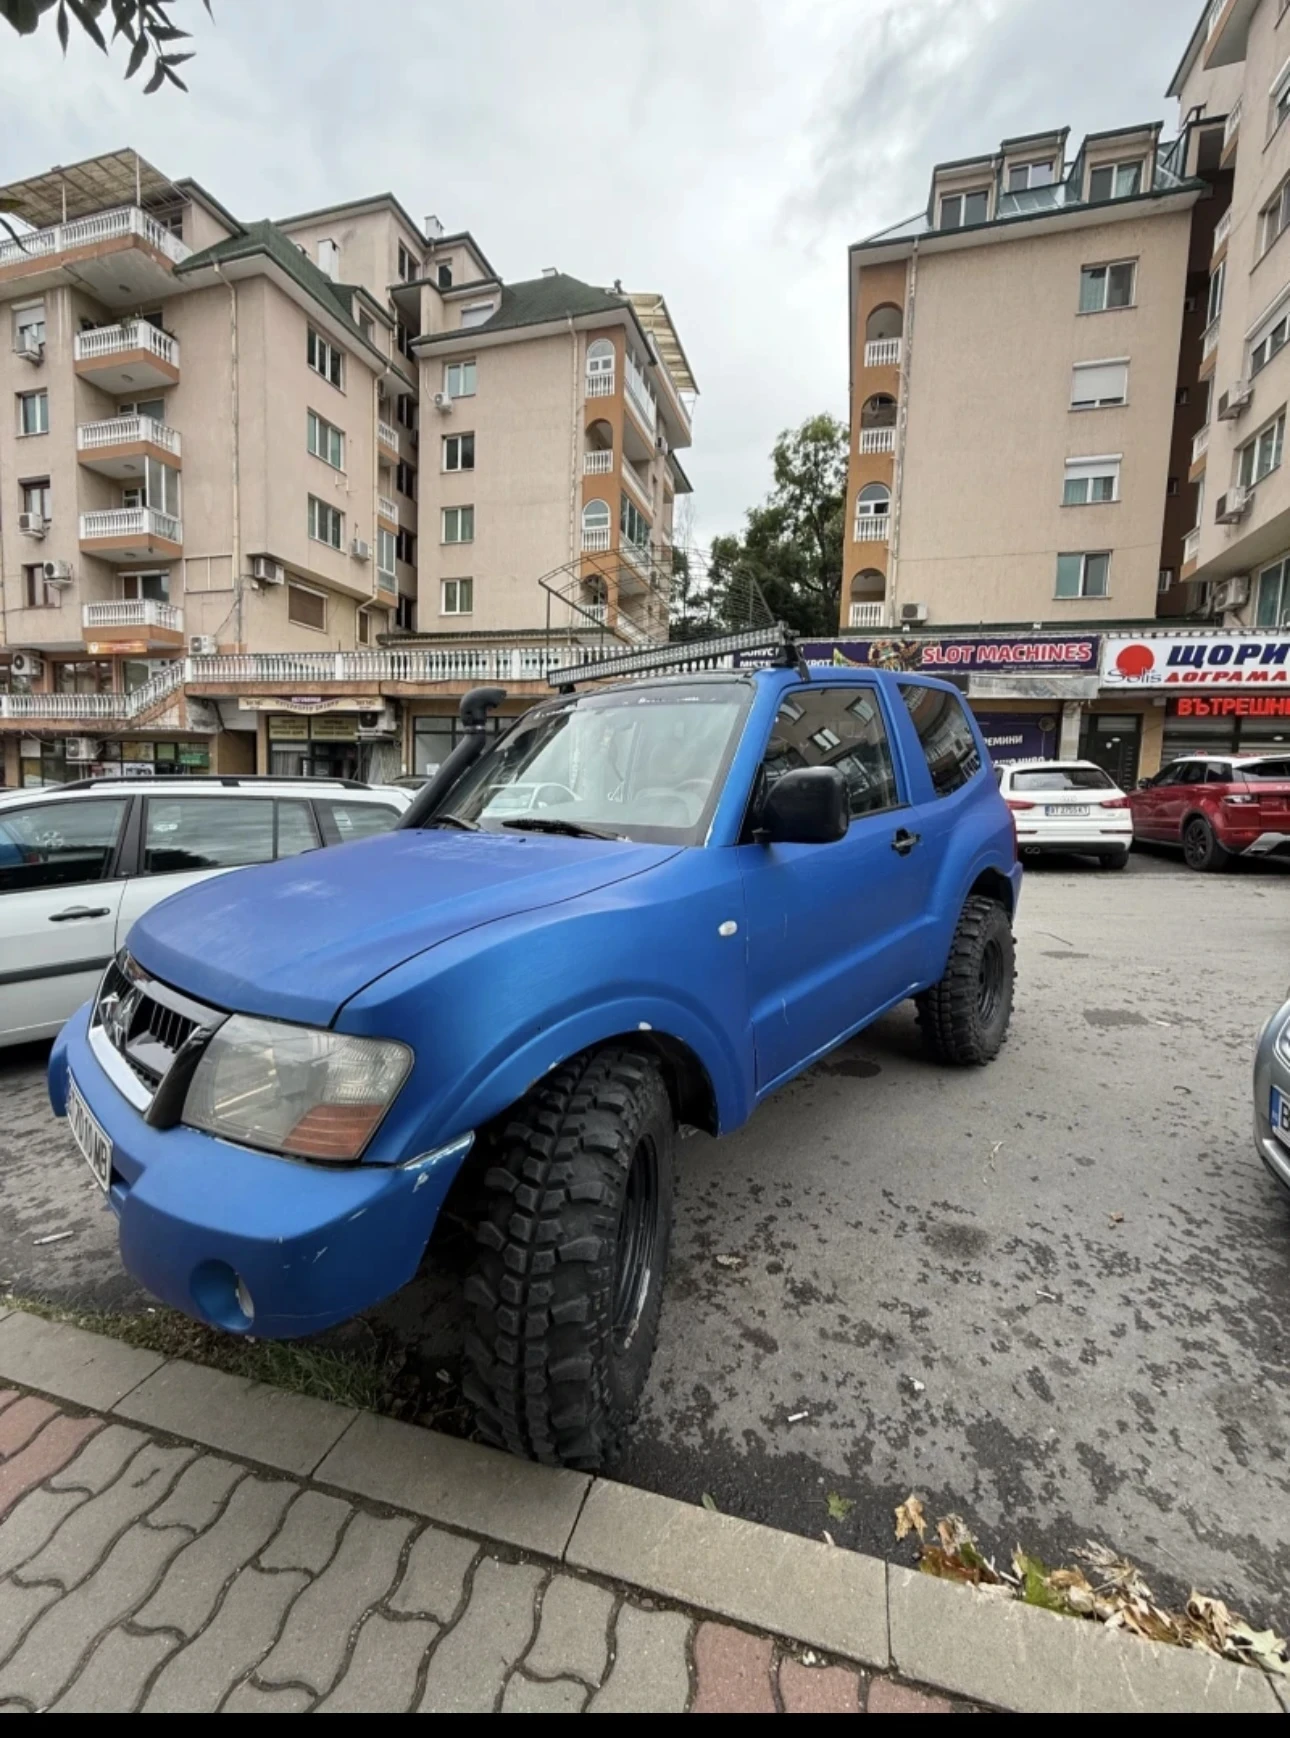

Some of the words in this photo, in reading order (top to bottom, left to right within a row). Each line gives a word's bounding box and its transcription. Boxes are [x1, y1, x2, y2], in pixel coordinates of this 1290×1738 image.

[922, 645, 975, 664] SLOT
[977, 642, 1092, 663] MACHINES
[1166, 643, 1290, 668] ЩОРИ
[1164, 671, 1287, 683] ДОГРАМА
